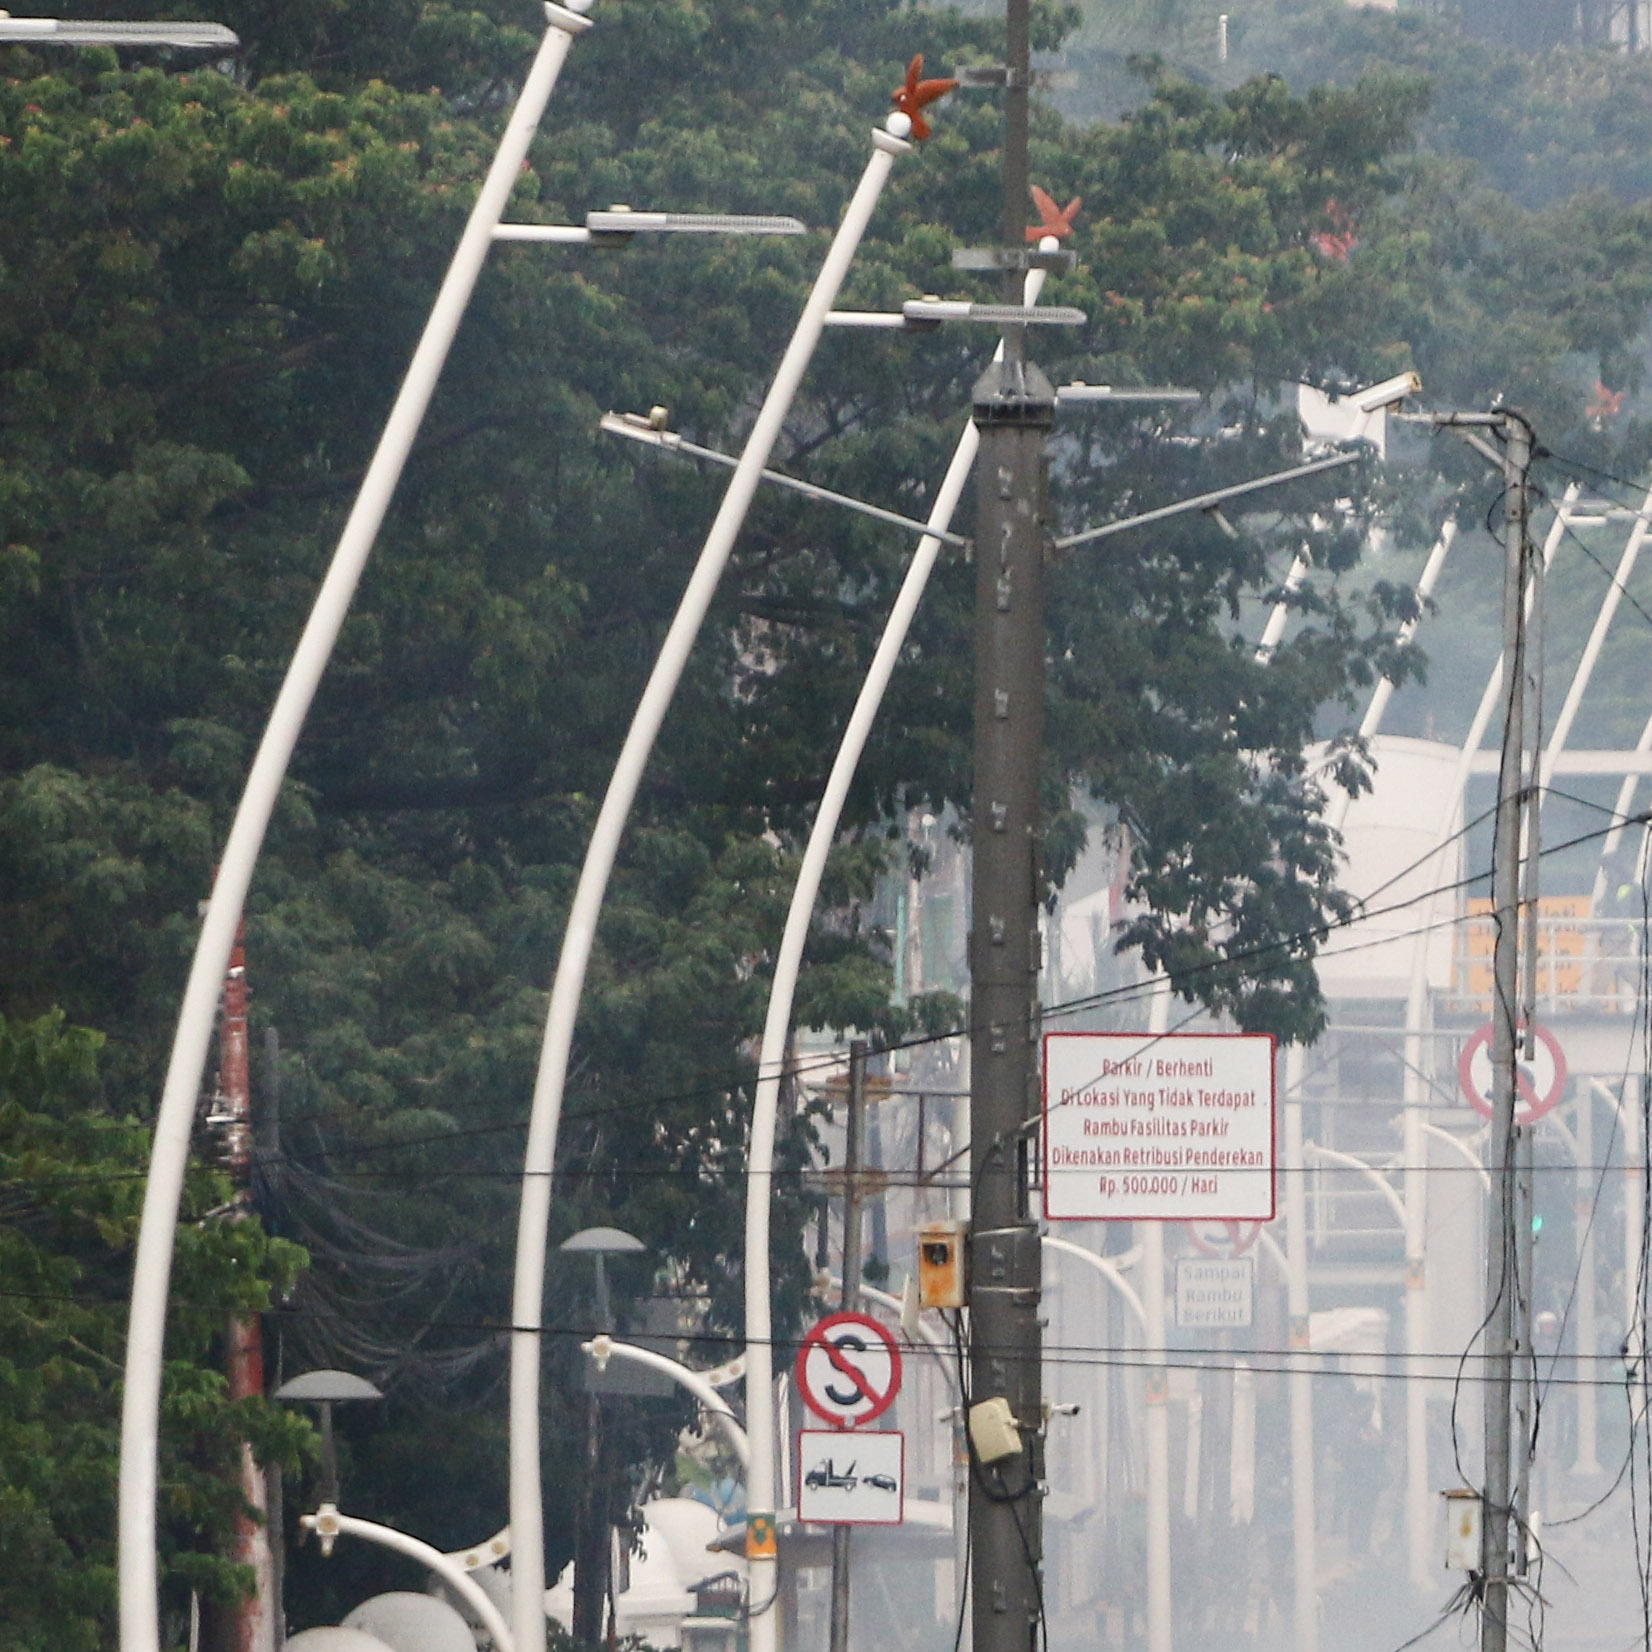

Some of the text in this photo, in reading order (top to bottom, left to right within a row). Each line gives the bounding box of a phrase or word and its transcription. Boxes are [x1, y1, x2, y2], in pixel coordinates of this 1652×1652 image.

[1103, 1057, 1213, 1078] Parkir / Berhenti
[1061, 1088, 1255, 1110] Di Lokasi Yang Tidak Terdapat
[1083, 1117, 1230, 1136] Rambu Fasilitas Parkir
[1053, 1146, 1263, 1165] Dikenakan Retribusi Penderekan
[1099, 1176, 1120, 1199] Rp.
[1181, 1175, 1188, 1197] /
[1191, 1175, 1218, 1194] Hari
[1185, 1265, 1245, 1281] Sampai
[1185, 1289, 1243, 1304] Rambu
